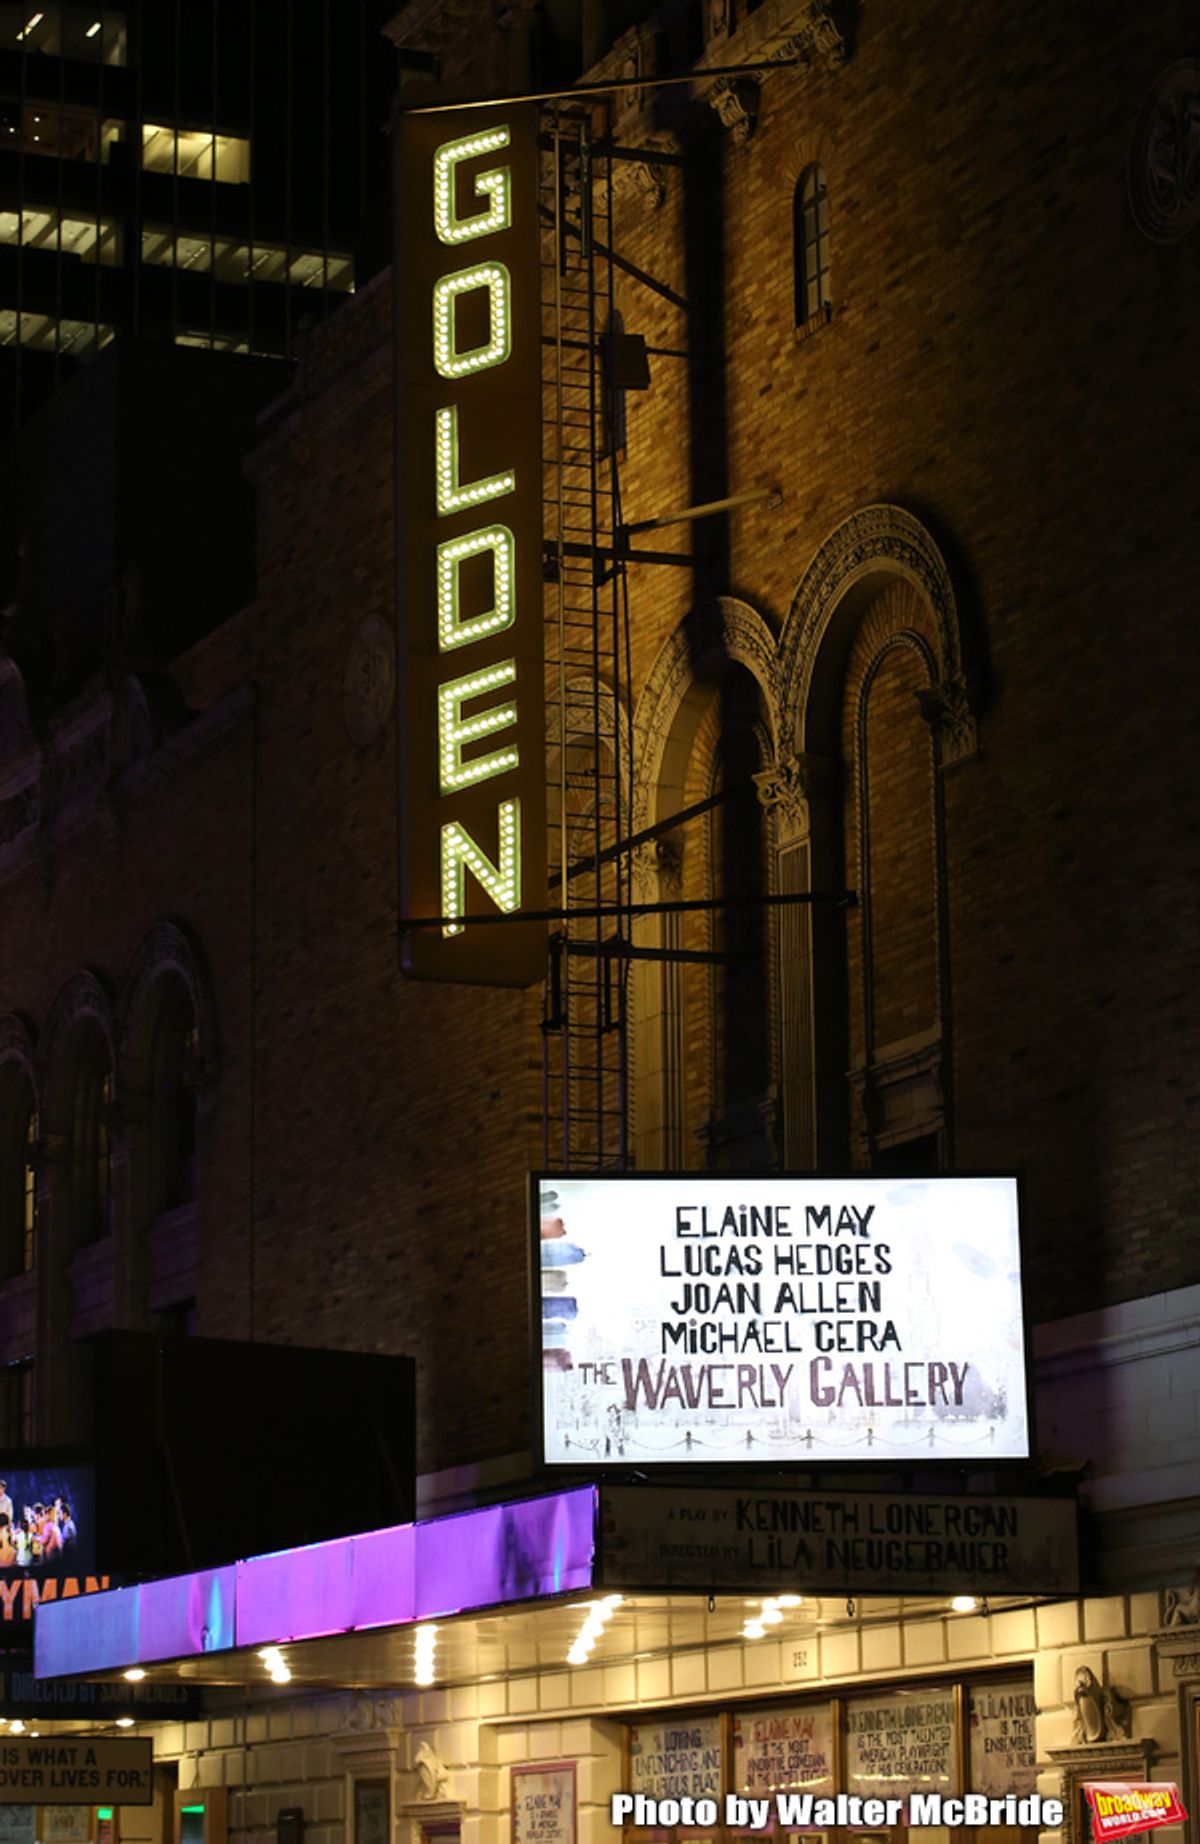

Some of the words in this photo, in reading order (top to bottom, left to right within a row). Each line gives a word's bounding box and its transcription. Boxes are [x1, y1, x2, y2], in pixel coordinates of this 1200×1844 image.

[432, 122, 522, 940] GOLDEN
[804, 1204, 876, 1239] MAY
[659, 1243, 763, 1278] LUCAS
[773, 1242, 893, 1277] HEDGES
[670, 1281, 762, 1315] JOAN
[773, 1280, 883, 1315] ALLEN
[814, 1320, 903, 1354] CERA
[577, 1361, 617, 1386] THE
[620, 1357, 794, 1411] WAVERLY
[808, 1355, 971, 1408] GALLERY
[679, 1510, 707, 1523] PLAY
[713, 1509, 728, 1522] BY
[735, 1498, 861, 1535] KENNETH
[868, 1502, 1019, 1538] LONERGAN
[826, 1539, 1010, 1574] NEUGEBAUER
[2, 1747, 20, 1765] IS
[27, 1747, 79, 1766] WHAT
[84, 1747, 97, 1766] A
[867, 1732, 884, 1748] THE
[51, 1769, 100, 1787] LIVES
